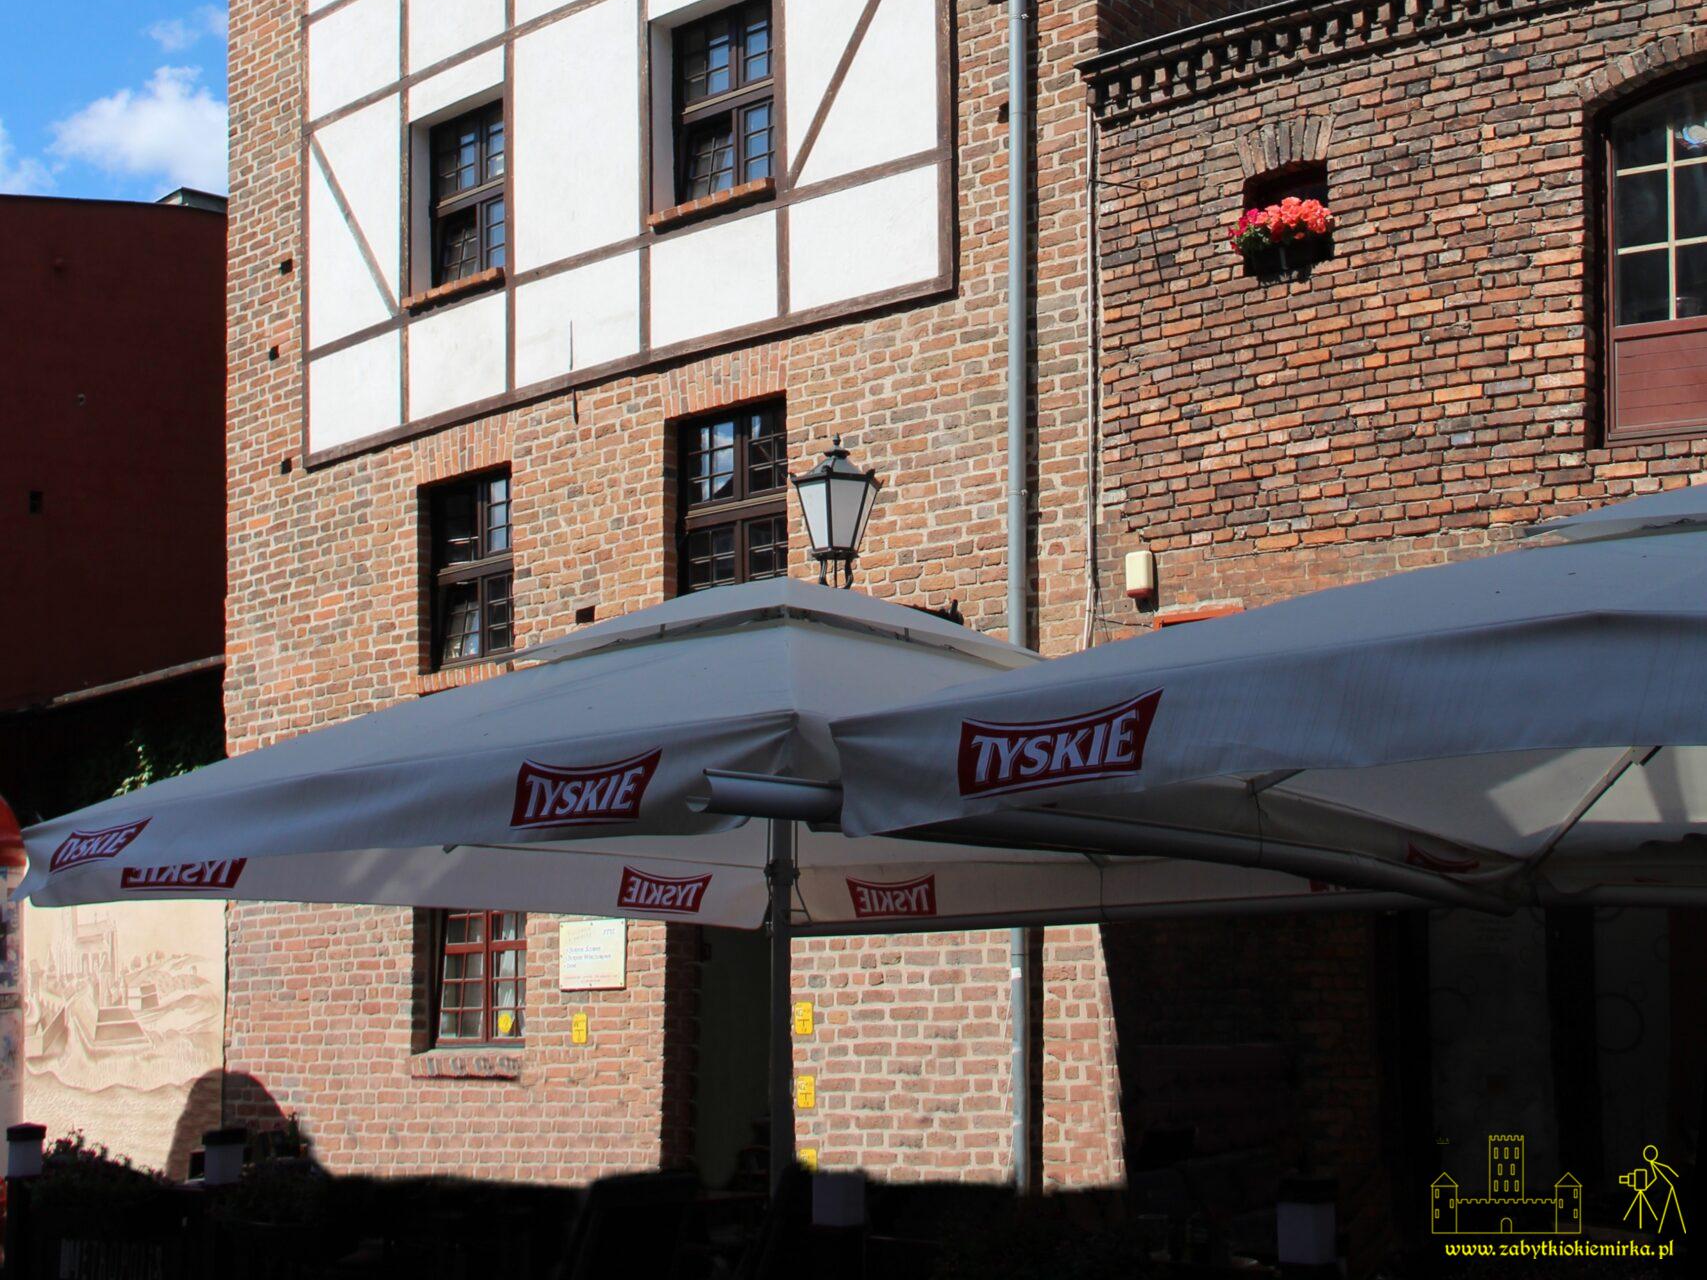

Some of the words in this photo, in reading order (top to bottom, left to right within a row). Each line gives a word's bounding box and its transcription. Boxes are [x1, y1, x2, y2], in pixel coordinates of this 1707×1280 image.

[970, 706, 1138, 784] TYSKIE
[523, 766, 646, 818] TYSKIE
[55, 826, 136, 864] TYSKIE
